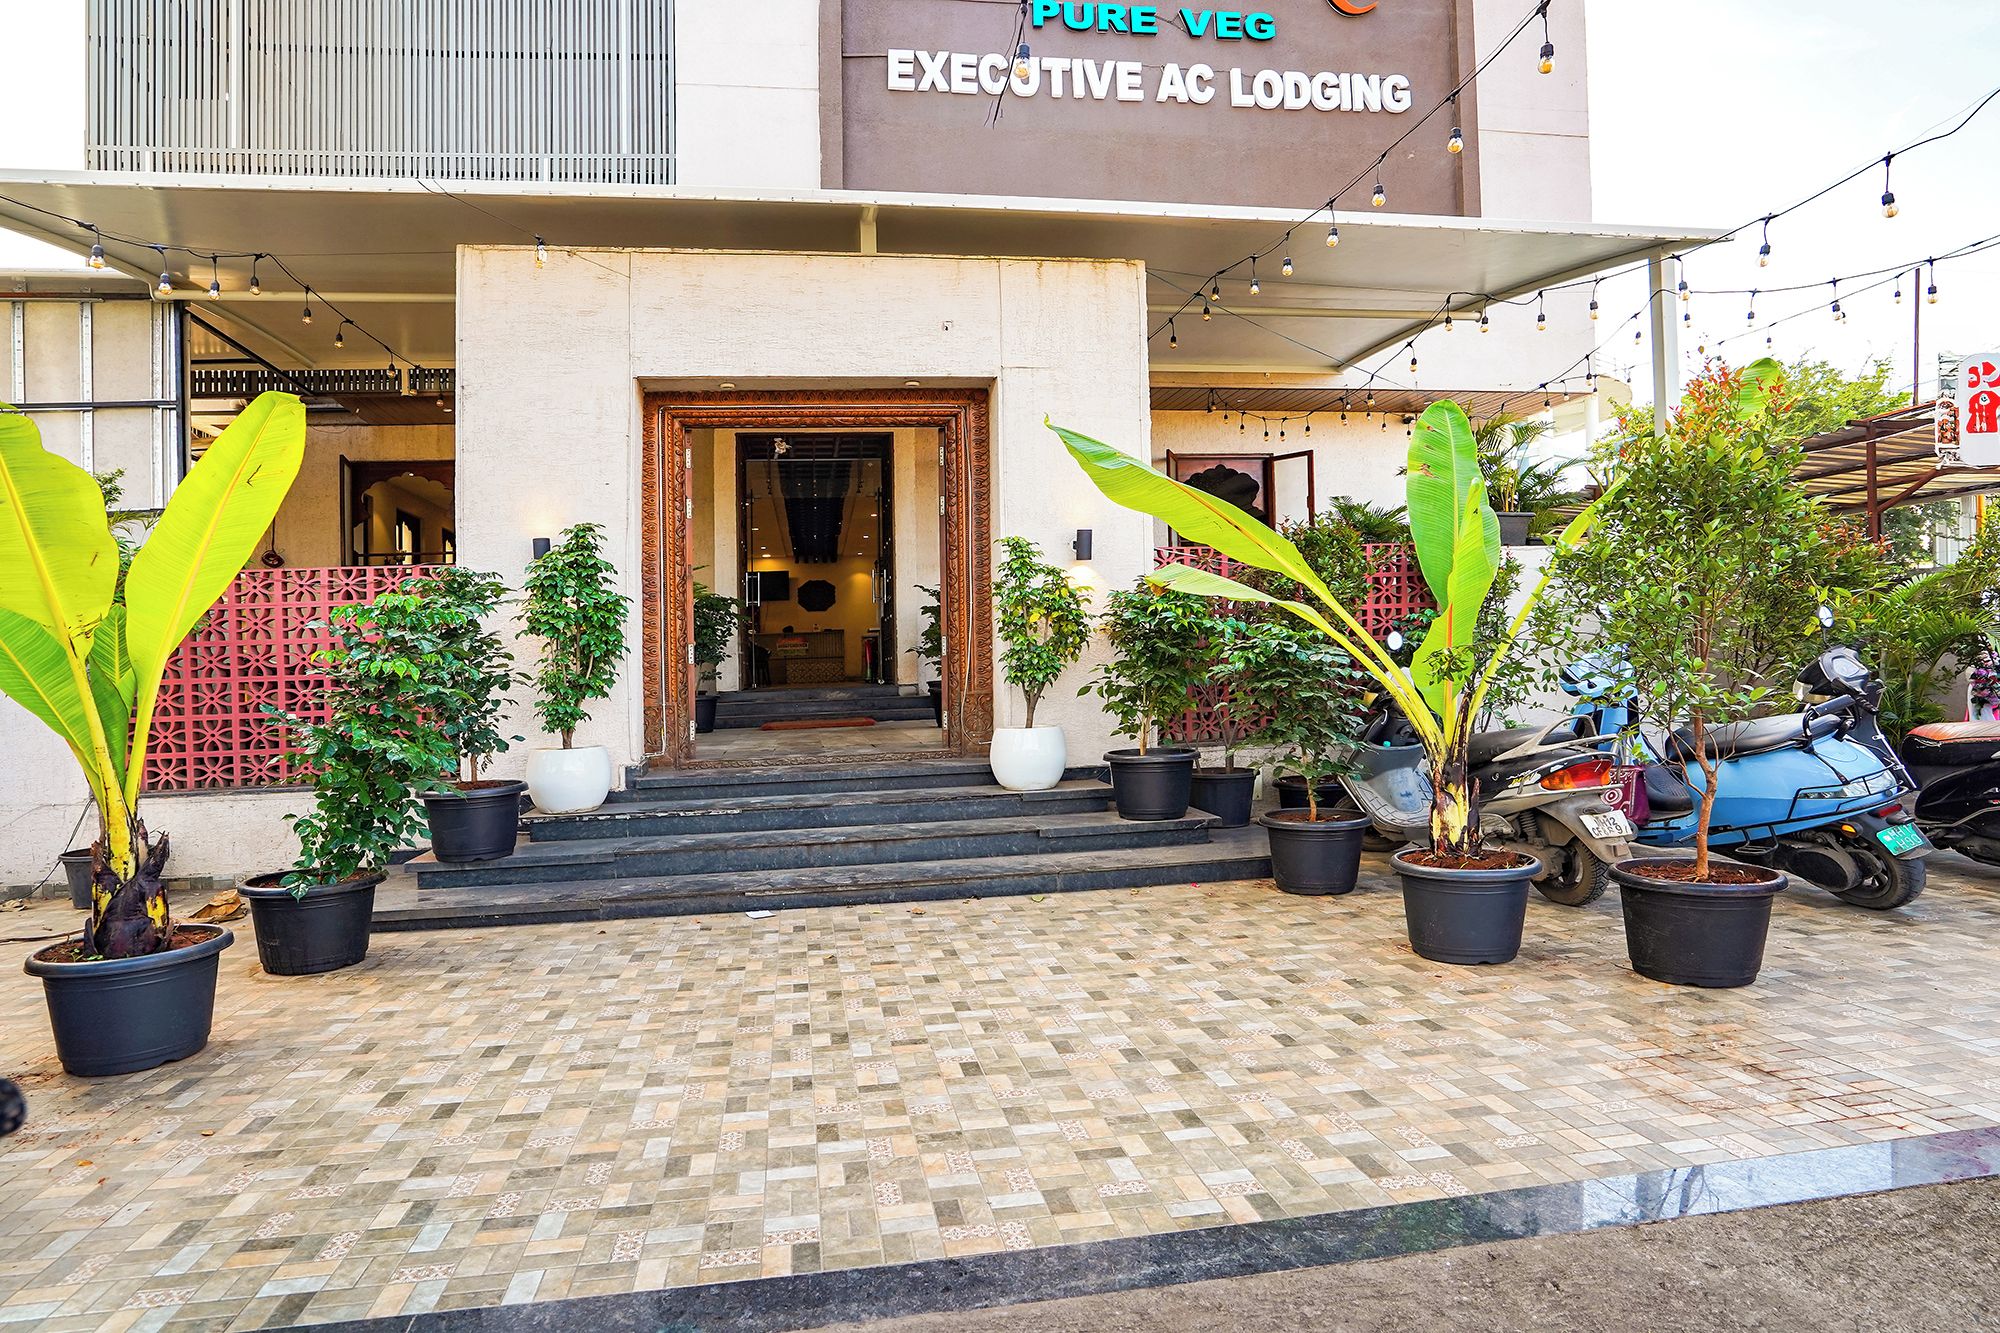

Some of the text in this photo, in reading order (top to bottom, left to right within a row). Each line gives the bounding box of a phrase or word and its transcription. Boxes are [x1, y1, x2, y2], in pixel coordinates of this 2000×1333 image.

[1032, 0, 1276, 41] PURE VEG
[887, 48, 1412, 114] EXECUTIVE AC LODGING
